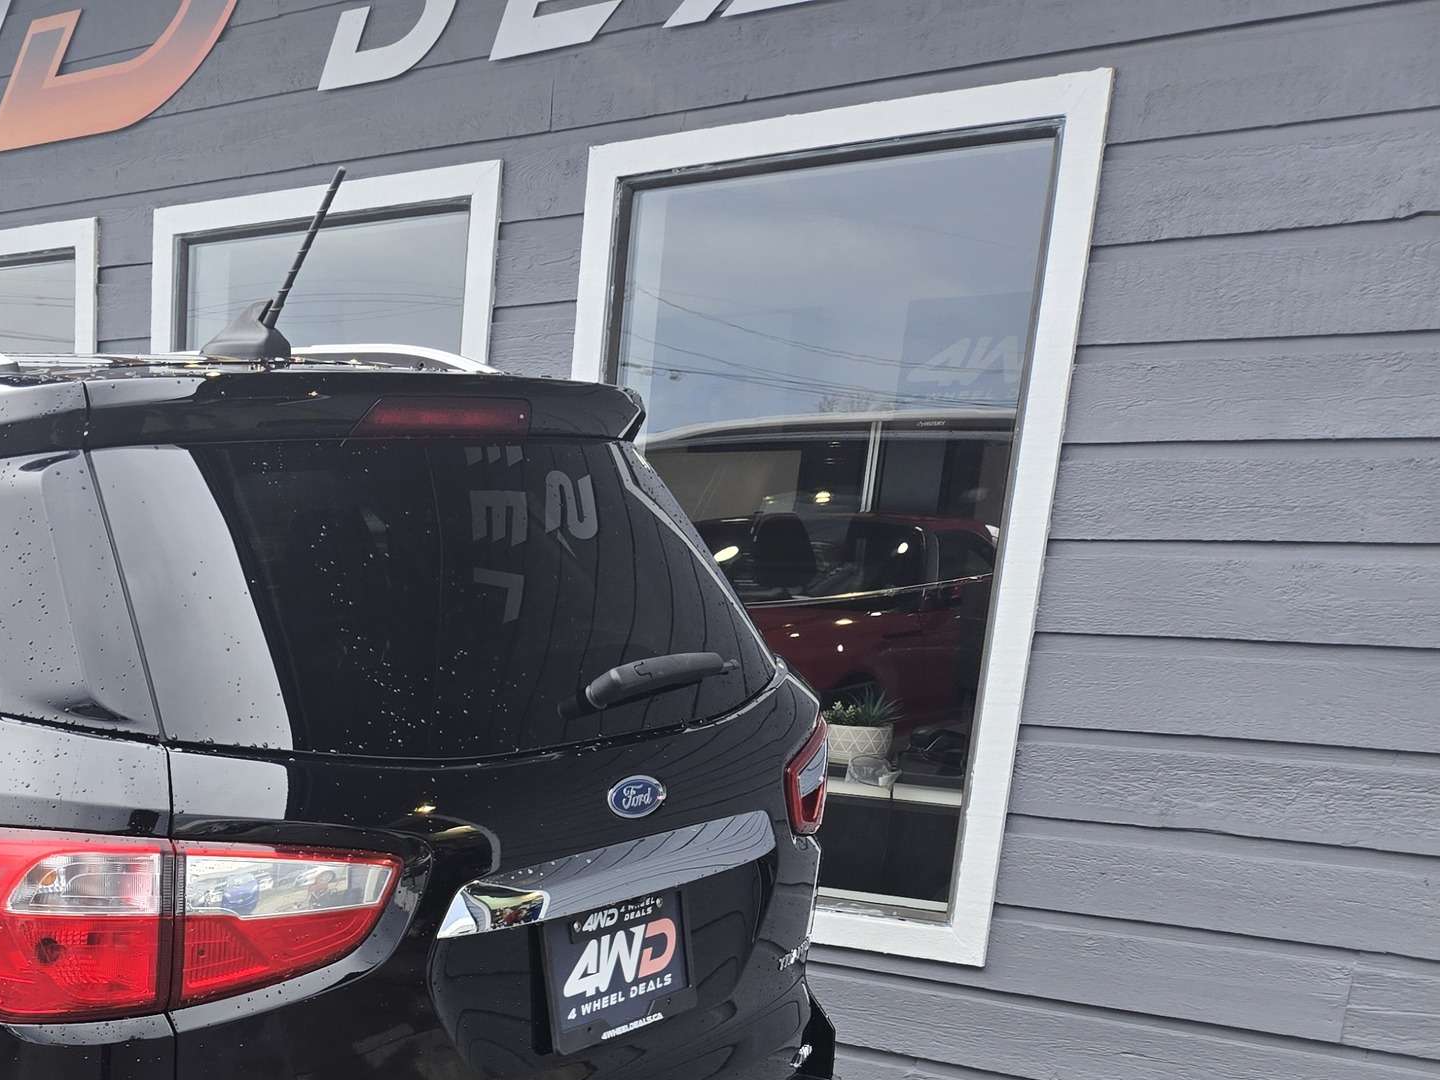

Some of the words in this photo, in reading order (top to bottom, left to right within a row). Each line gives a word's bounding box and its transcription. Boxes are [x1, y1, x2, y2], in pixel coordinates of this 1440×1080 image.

[622, 783, 653, 810] Ford
[624, 906, 653, 921] DEALS
[563, 917, 677, 997] 4WD
[567, 1007, 577, 1020] 4
[580, 991, 626, 1016] WHEEL
[629, 973, 673, 998] DEALS
